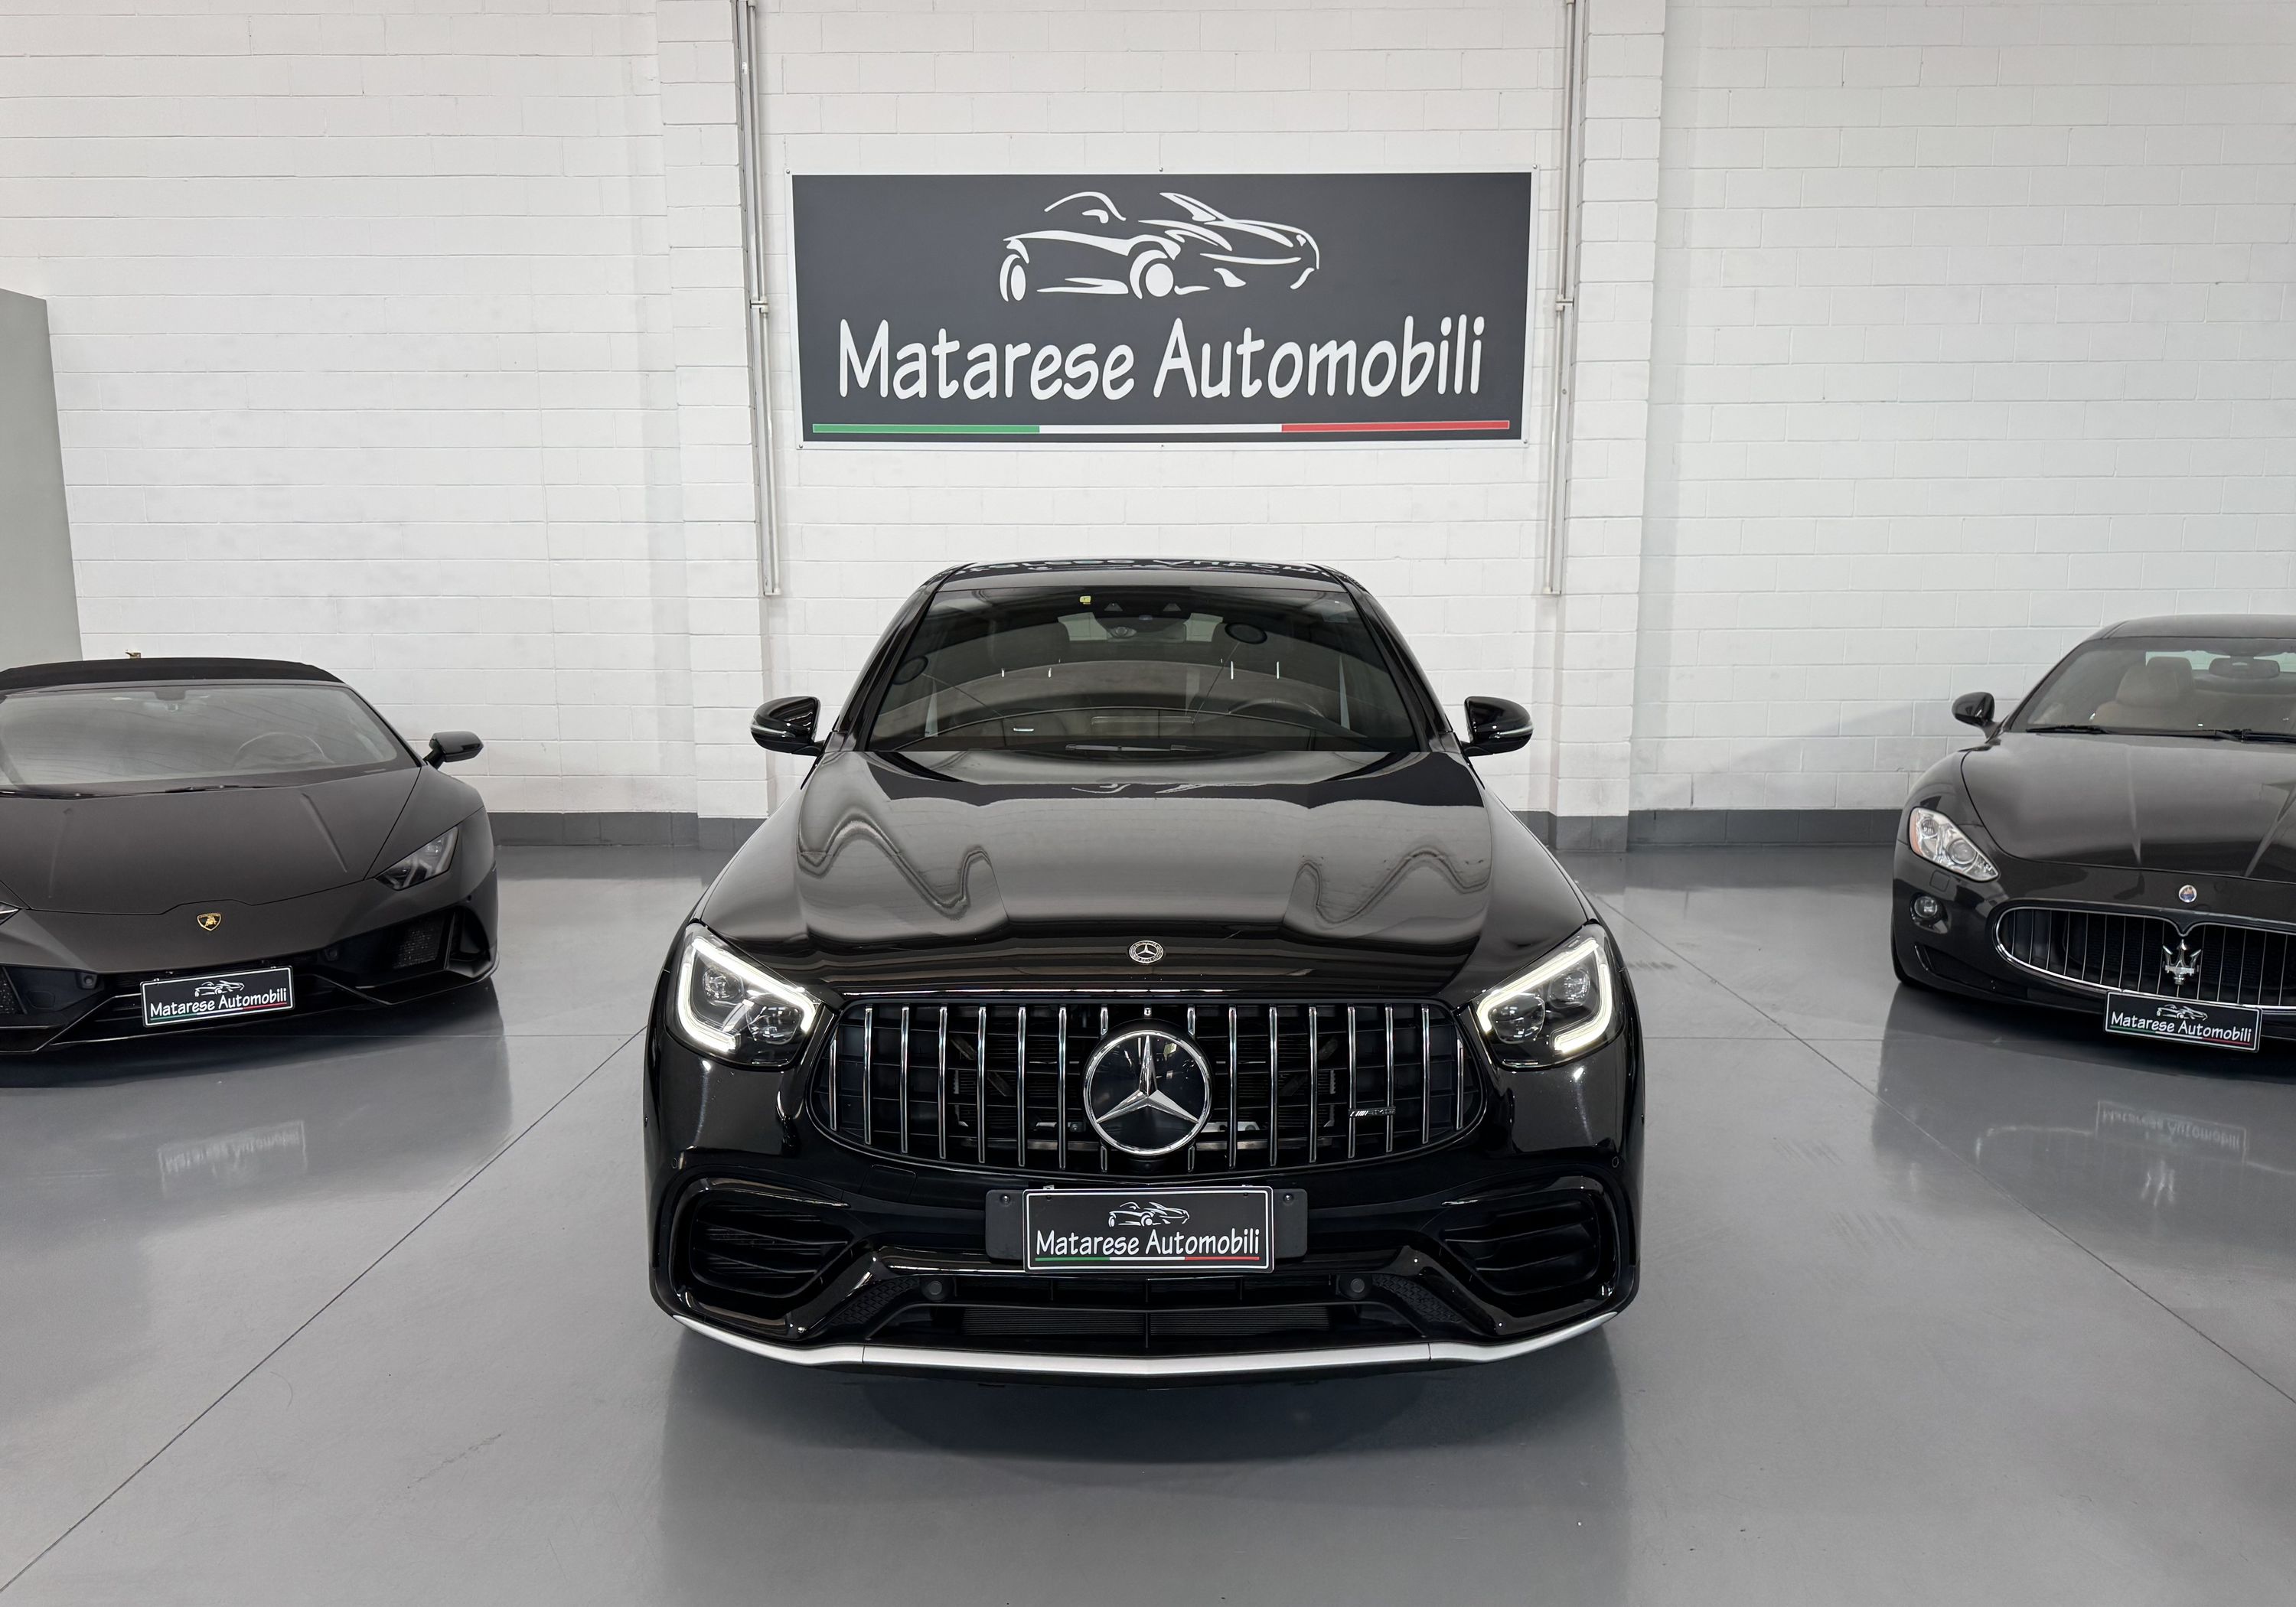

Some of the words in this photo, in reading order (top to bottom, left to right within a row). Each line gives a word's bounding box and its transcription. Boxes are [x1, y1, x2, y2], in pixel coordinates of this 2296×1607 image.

[839, 318, 1135, 400] Matarese
[1153, 314, 1485, 399] Automobili
[150, 1000, 216, 1018] Matarese
[218, 988, 288, 1009] Automobili
[2111, 1011, 2175, 1033] Matarese
[2177, 1019, 2252, 1043] Automobili
[1035, 1230, 1140, 1256] Matarese
[1145, 1228, 1260, 1255] Automobili
